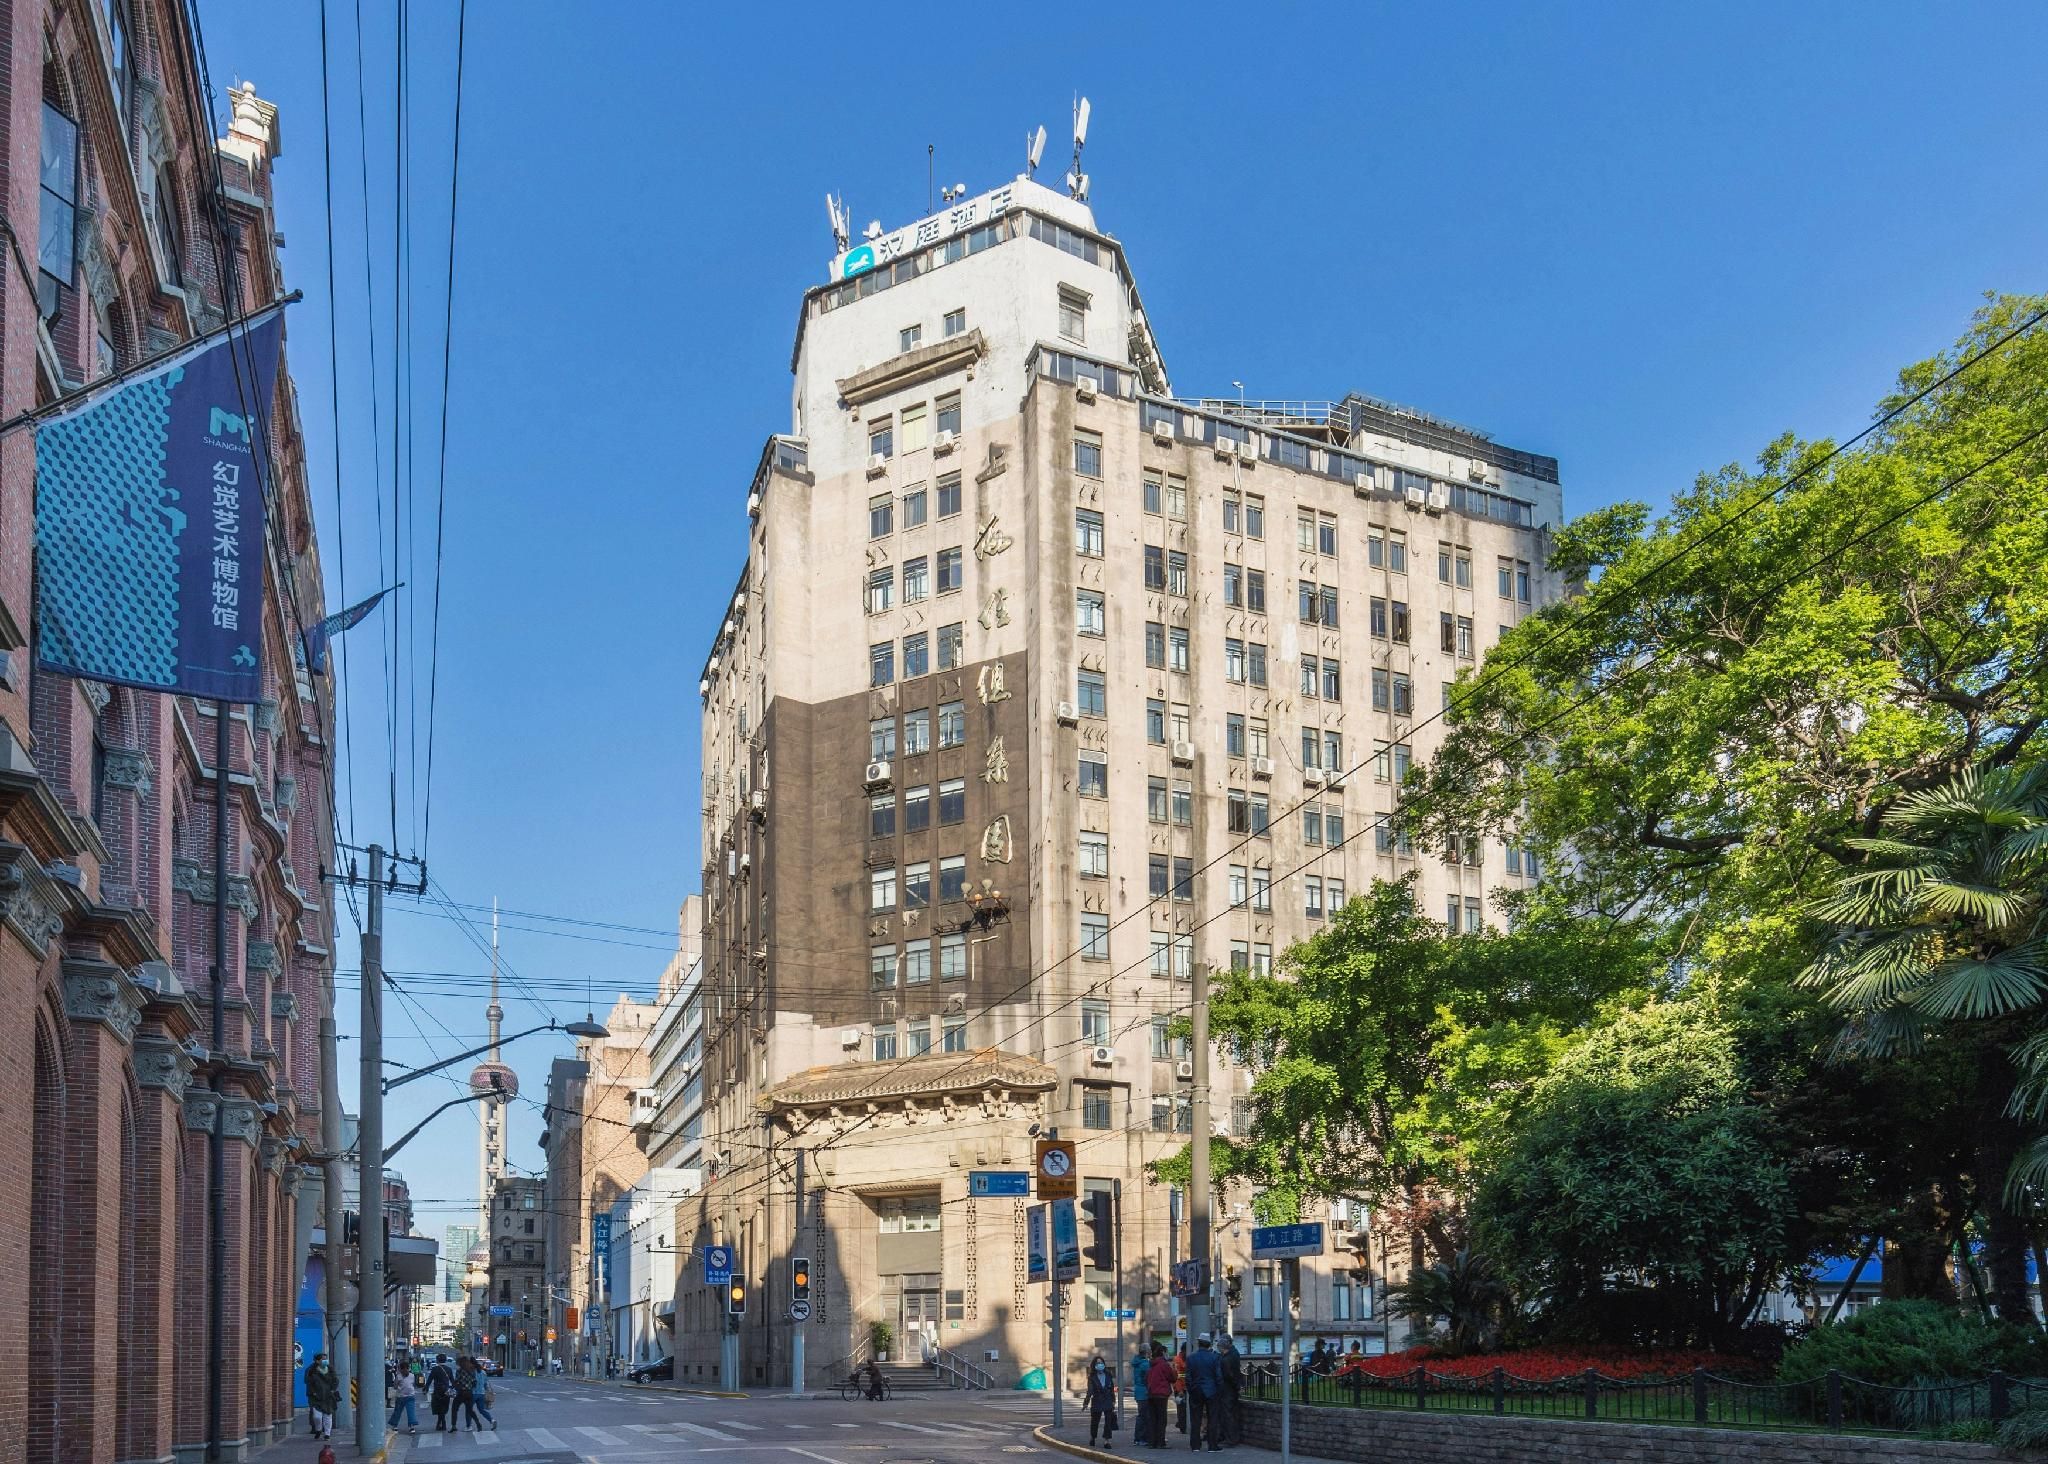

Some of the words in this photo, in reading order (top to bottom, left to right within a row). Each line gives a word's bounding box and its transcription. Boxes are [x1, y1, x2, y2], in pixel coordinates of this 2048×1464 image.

[880, 187, 1012, 263] 汉庭酒店
[203, 436, 251, 454] SHANGHAI
[212, 460, 240, 631] 幻觉艺术博物馆
[1268, 1228, 1304, 1245] 九江路
